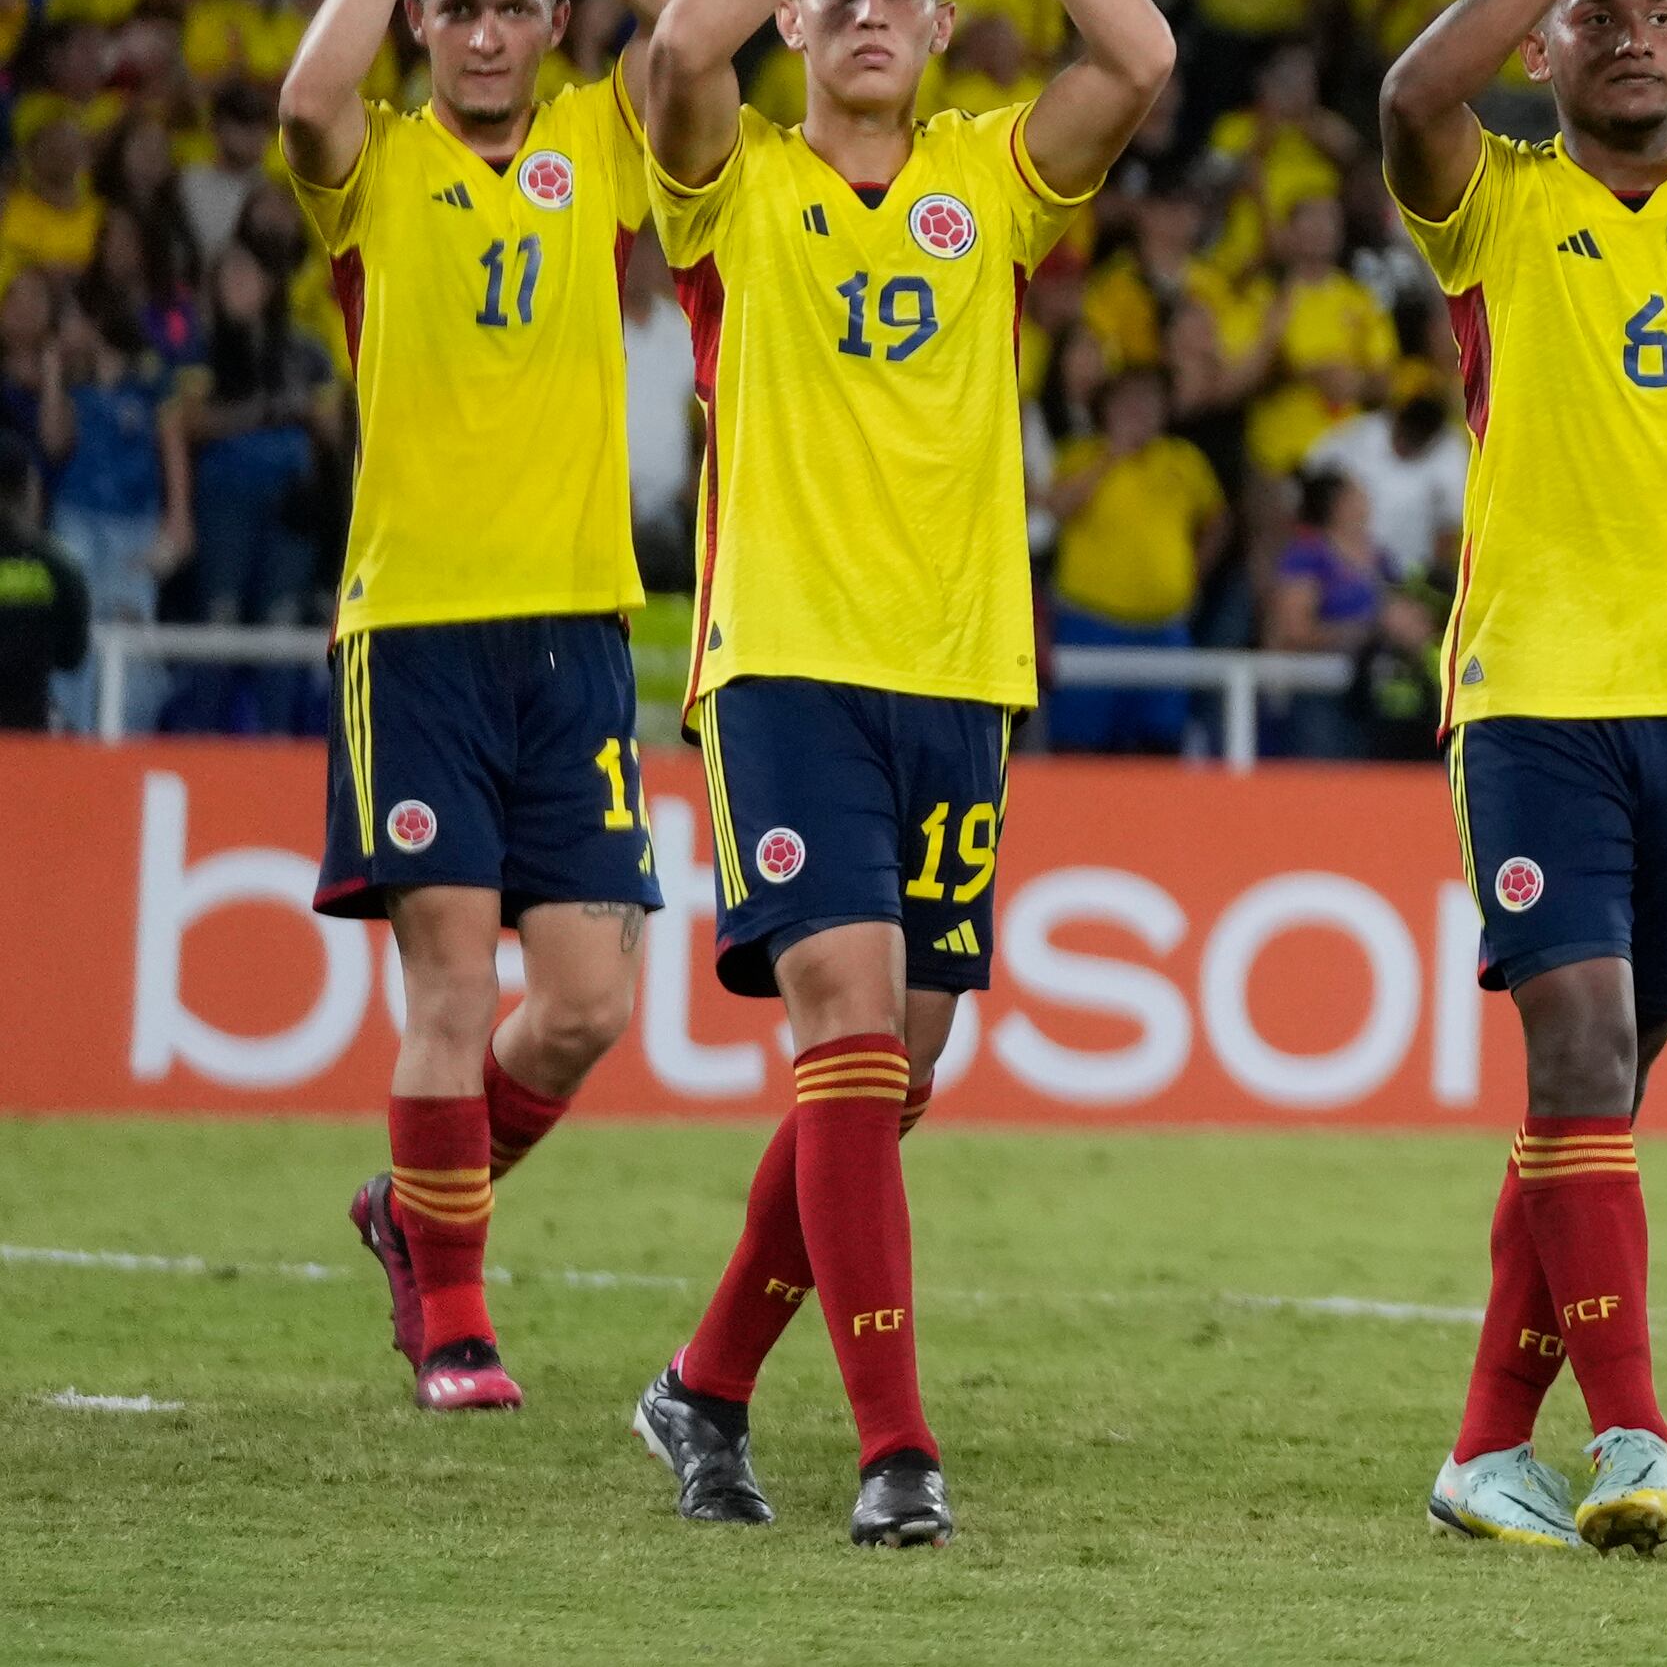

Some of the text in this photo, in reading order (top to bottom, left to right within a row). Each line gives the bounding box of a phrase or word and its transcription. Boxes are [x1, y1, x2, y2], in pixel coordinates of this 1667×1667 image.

[476, 233, 542, 328] 11
[836, 270, 939, 362] 19
[594, 737, 648, 831] 1
[906, 801, 997, 904] 19
[853, 1308, 906, 1337] FCF
[1562, 1295, 1621, 1330] FCF
